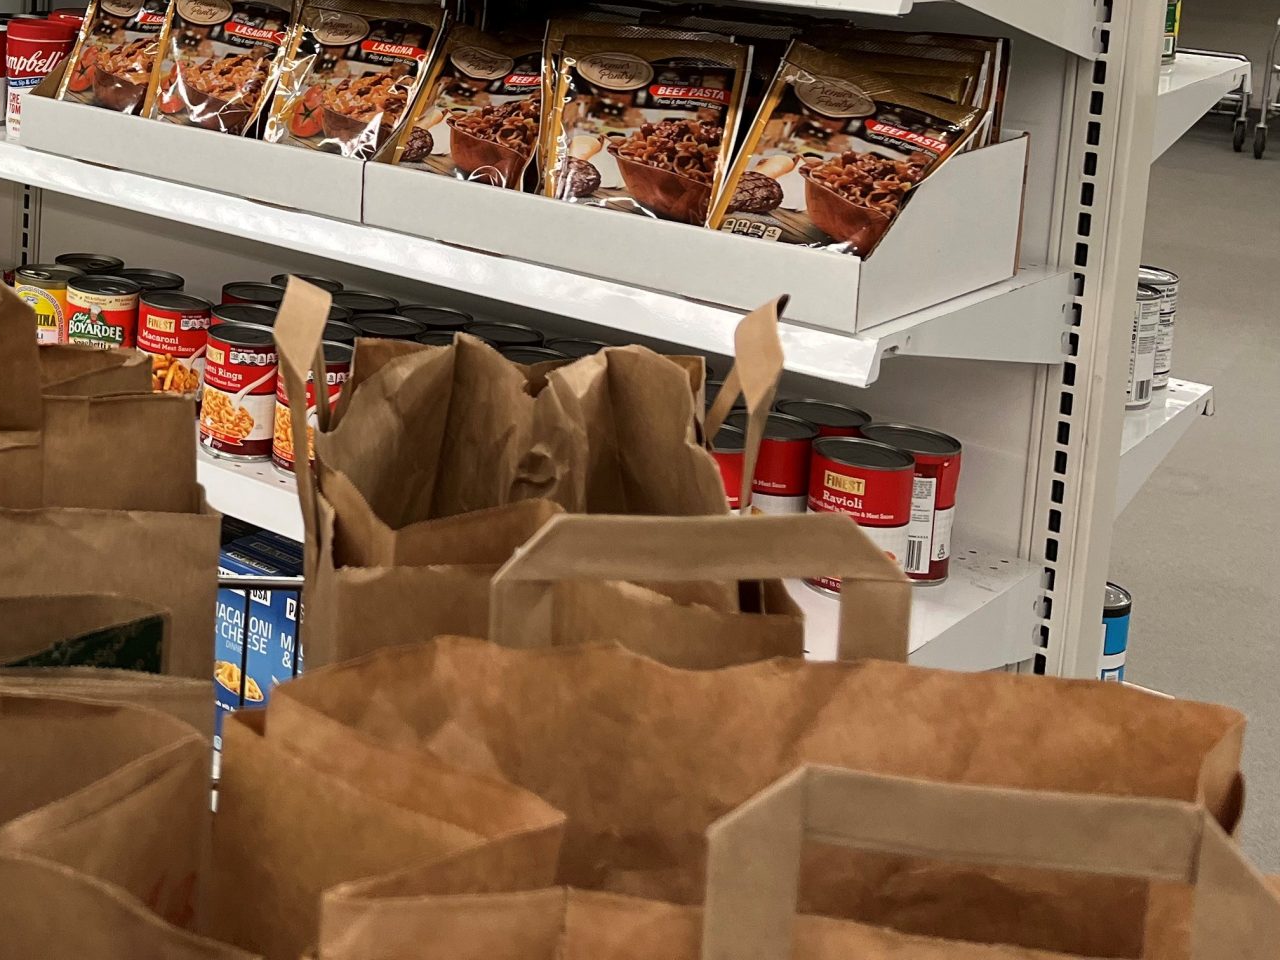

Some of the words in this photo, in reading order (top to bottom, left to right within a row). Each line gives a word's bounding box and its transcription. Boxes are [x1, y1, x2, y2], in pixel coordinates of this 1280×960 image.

[235, 25, 273, 39] LASAGNA
[372, 42, 414, 56] LASAGNA
[511, 75, 534, 84] BEEF
[599, 69, 636, 84] Pantry
[657, 86, 686, 96] BEEF
[689, 87, 724, 100] PASTA
[873, 123, 906, 137] BEEF
[908, 133, 948, 152] PASTA
[73, 312, 88, 323] Chef
[148, 316, 173, 330] FINEST
[69, 320, 123, 340] BOYARDEE
[142, 330, 179, 344] Macaroni
[218, 367, 243, 381] Rings
[826, 473, 862, 492] FINEST
[822, 490, 863, 509] Ravioli
[216, 601, 272, 639] ACAONI
